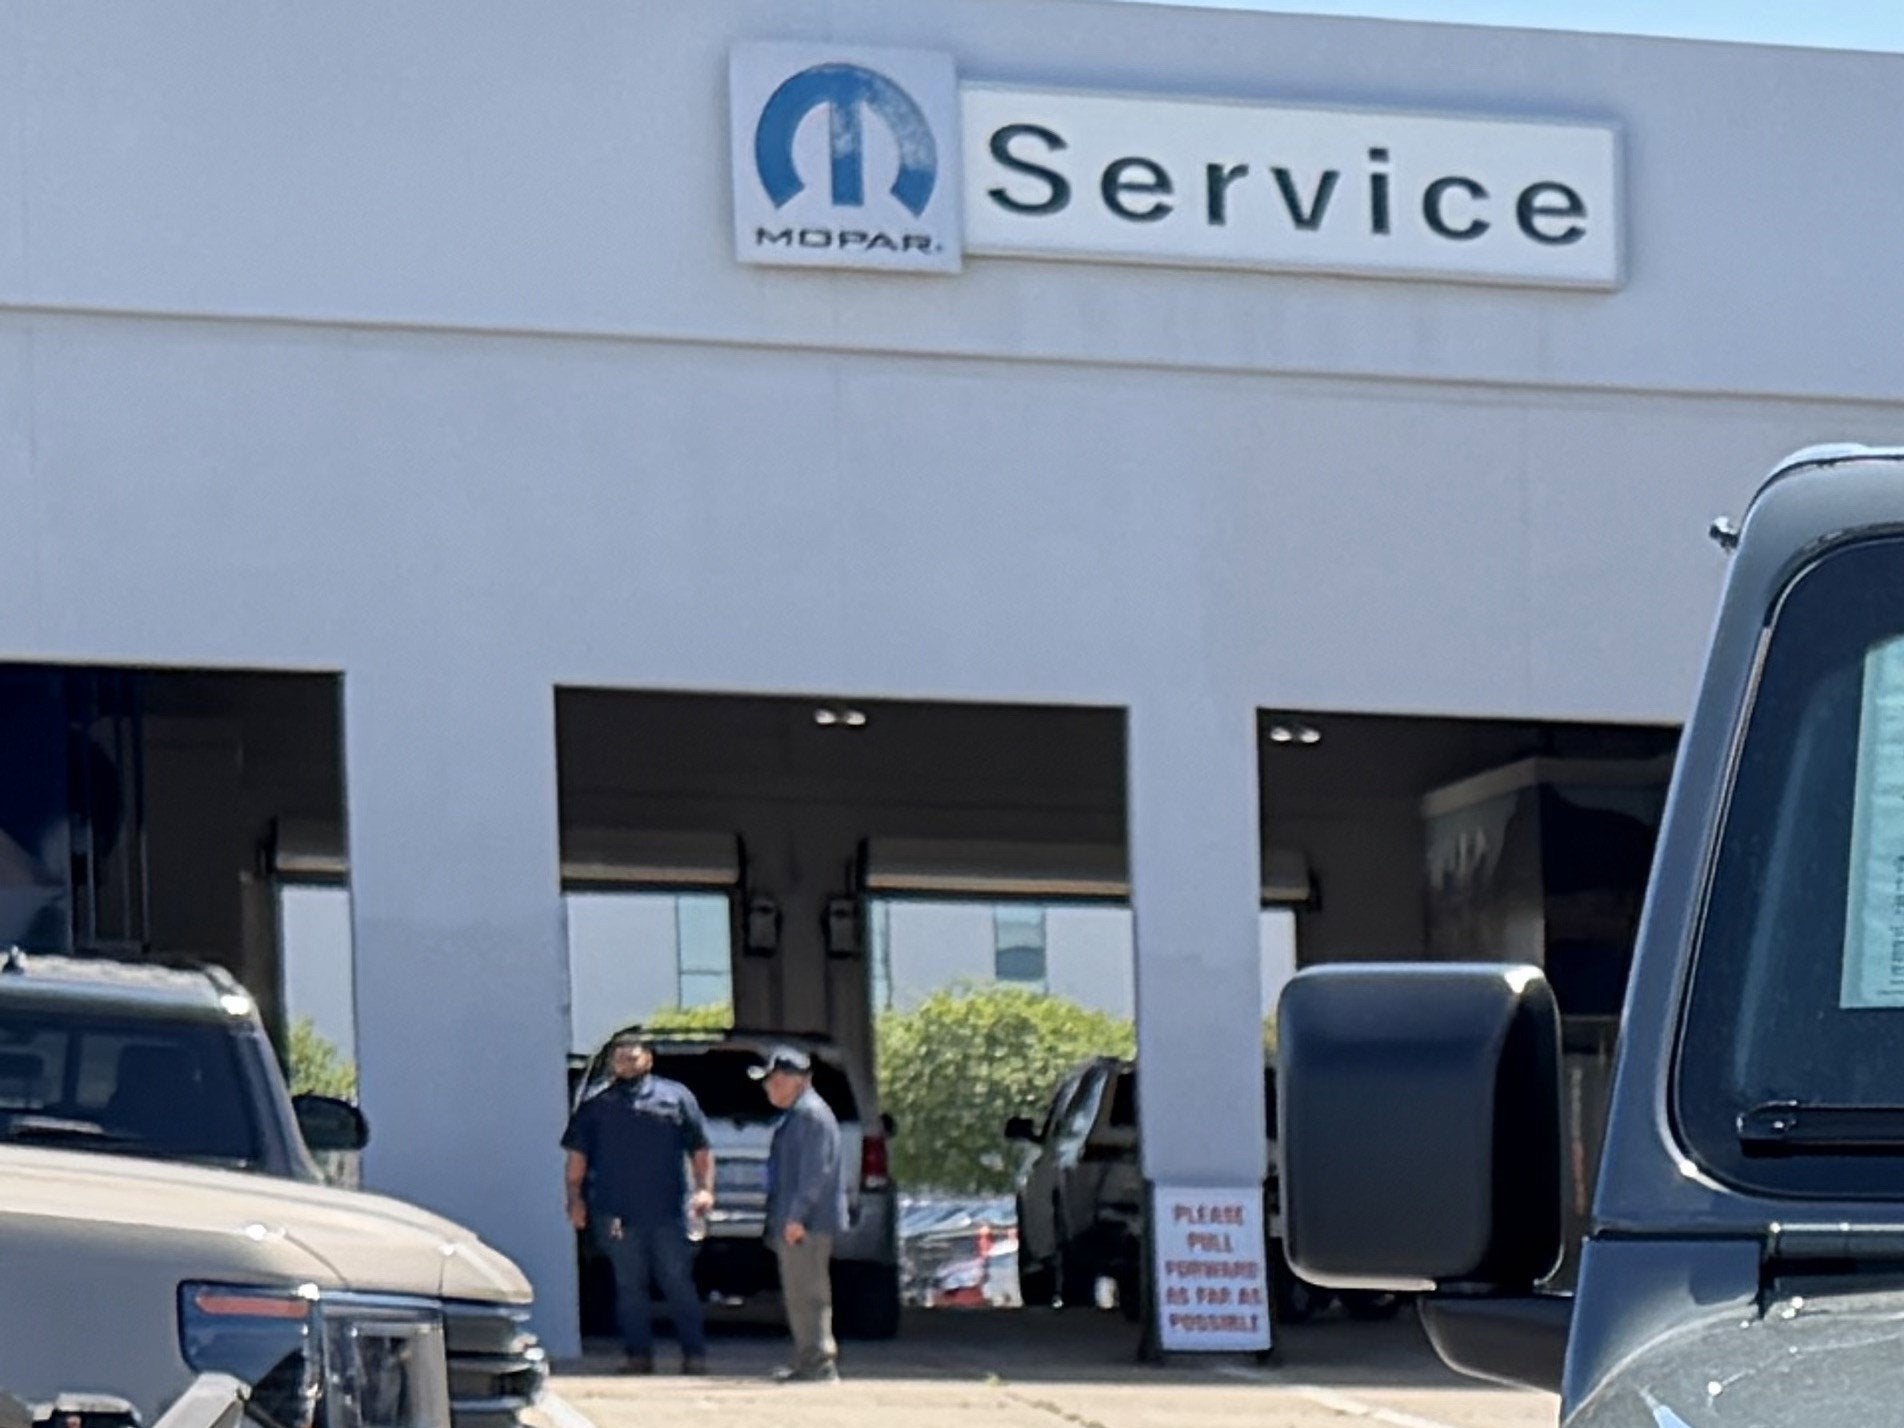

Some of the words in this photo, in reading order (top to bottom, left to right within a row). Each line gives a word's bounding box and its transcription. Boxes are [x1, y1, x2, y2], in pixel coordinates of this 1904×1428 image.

[986, 122, 1589, 247] Service
[755, 227, 933, 254] MOPAR
[1173, 1204, 1243, 1226] PLEASE
[1187, 1231, 1233, 1253] PULL
[1165, 1259, 1257, 1280] FORWARD
[1166, 1286, 1189, 1306] AS
[1196, 1286, 1230, 1306] FAR
[1238, 1286, 1260, 1306] AS
[1169, 1312, 1258, 1333] POSSIBLE
